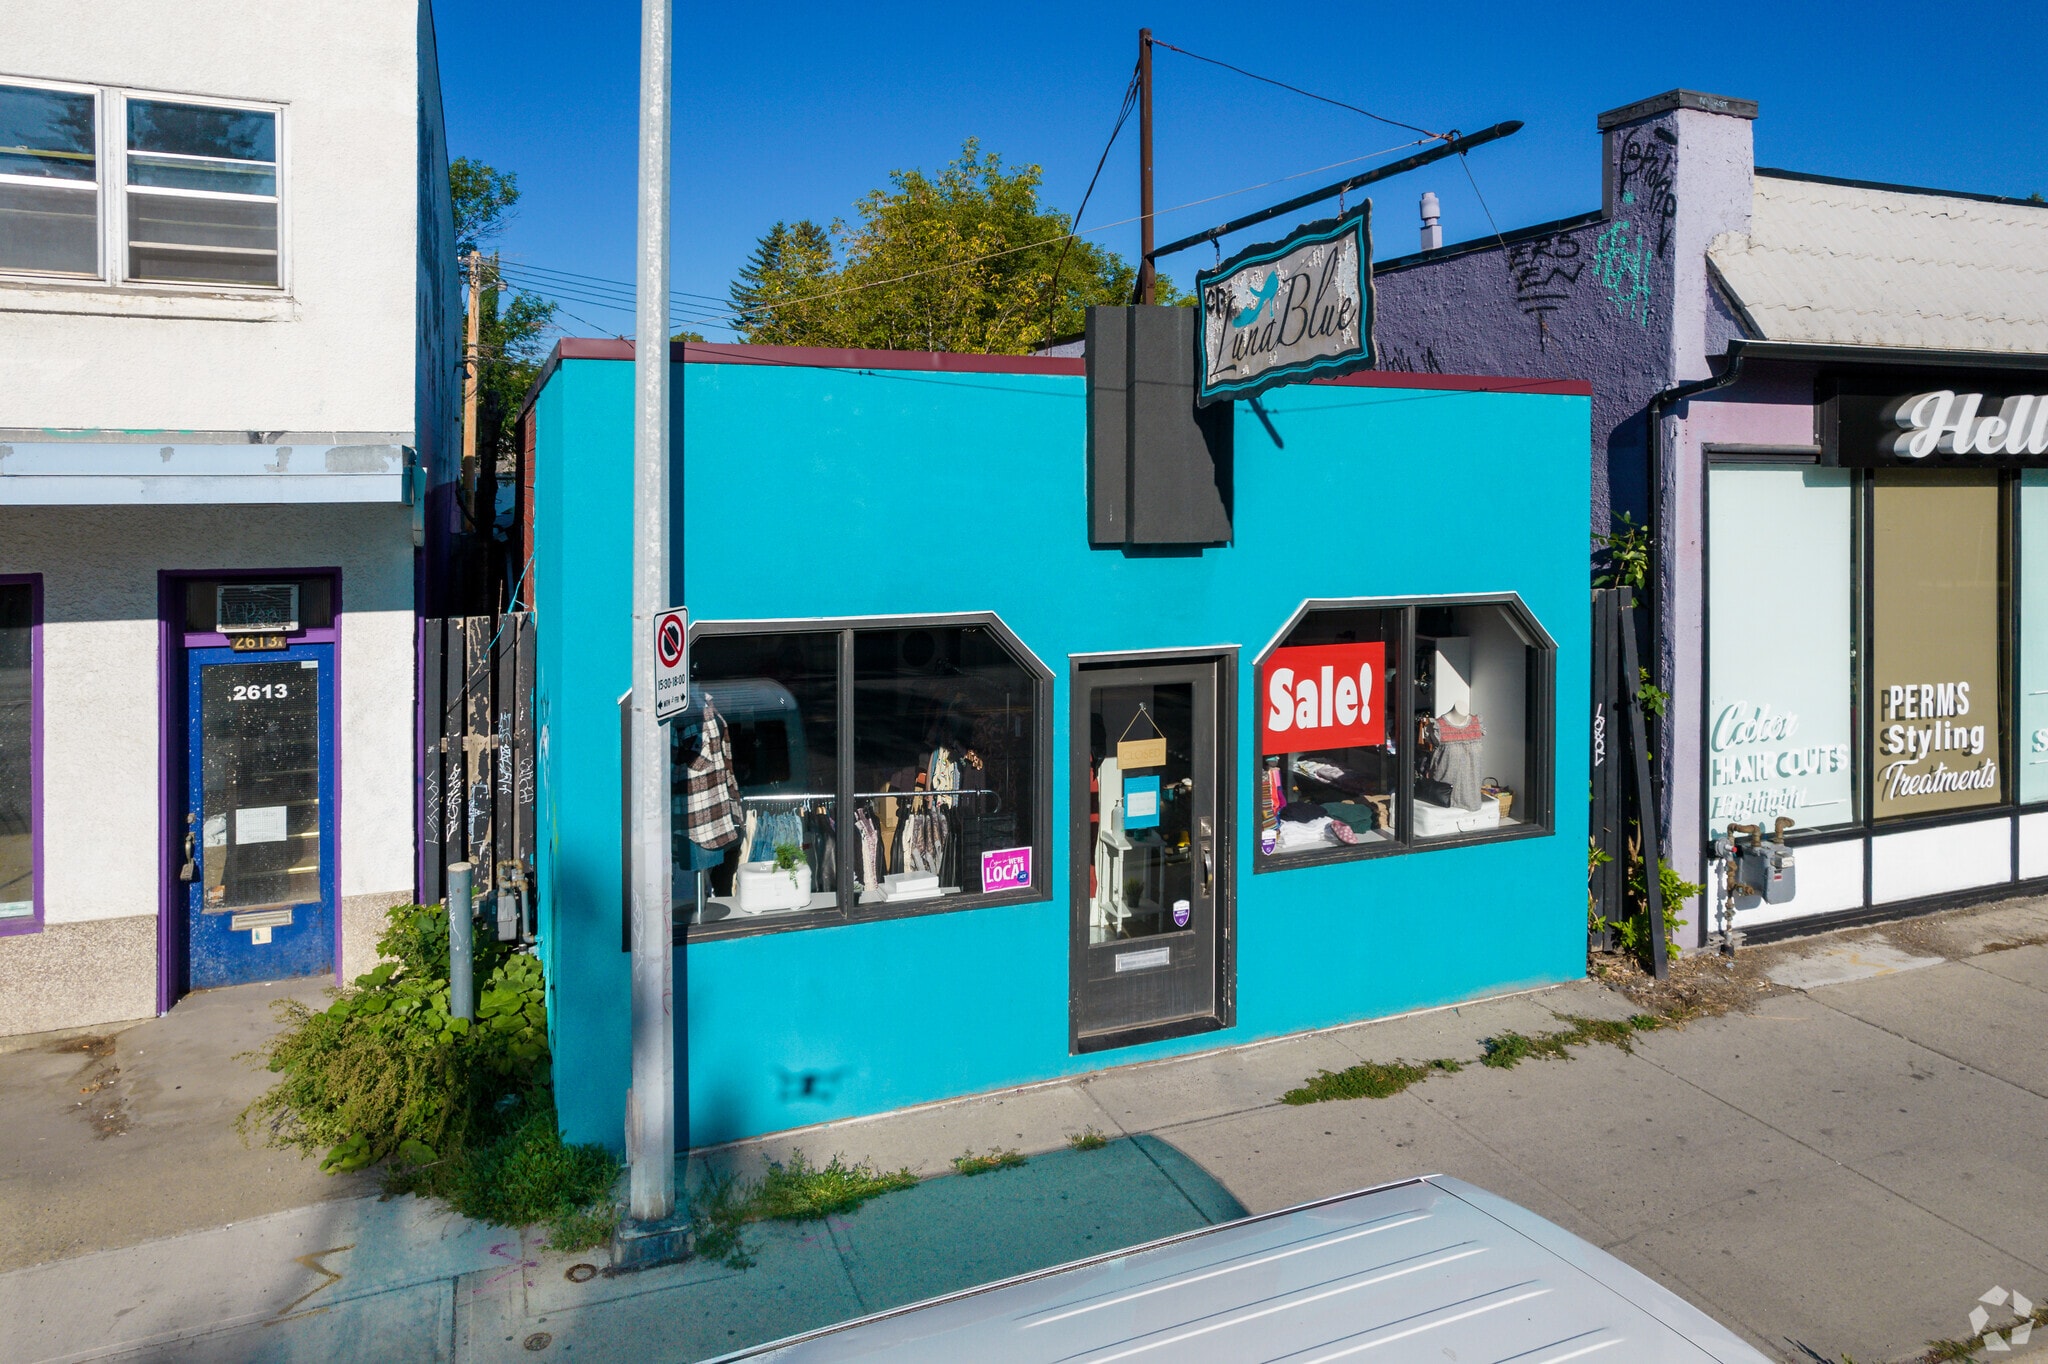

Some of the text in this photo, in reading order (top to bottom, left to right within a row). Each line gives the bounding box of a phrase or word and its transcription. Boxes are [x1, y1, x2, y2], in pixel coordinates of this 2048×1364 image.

[233, 683, 288, 701] 2613
[1267, 662, 1373, 732] Sale!
[1889, 681, 1970, 719] PERMS
[1122, 748, 1161, 761] CLOSED
[1887, 720, 1985, 760] Styling
[1886, 757, 1996, 800] Treatments
